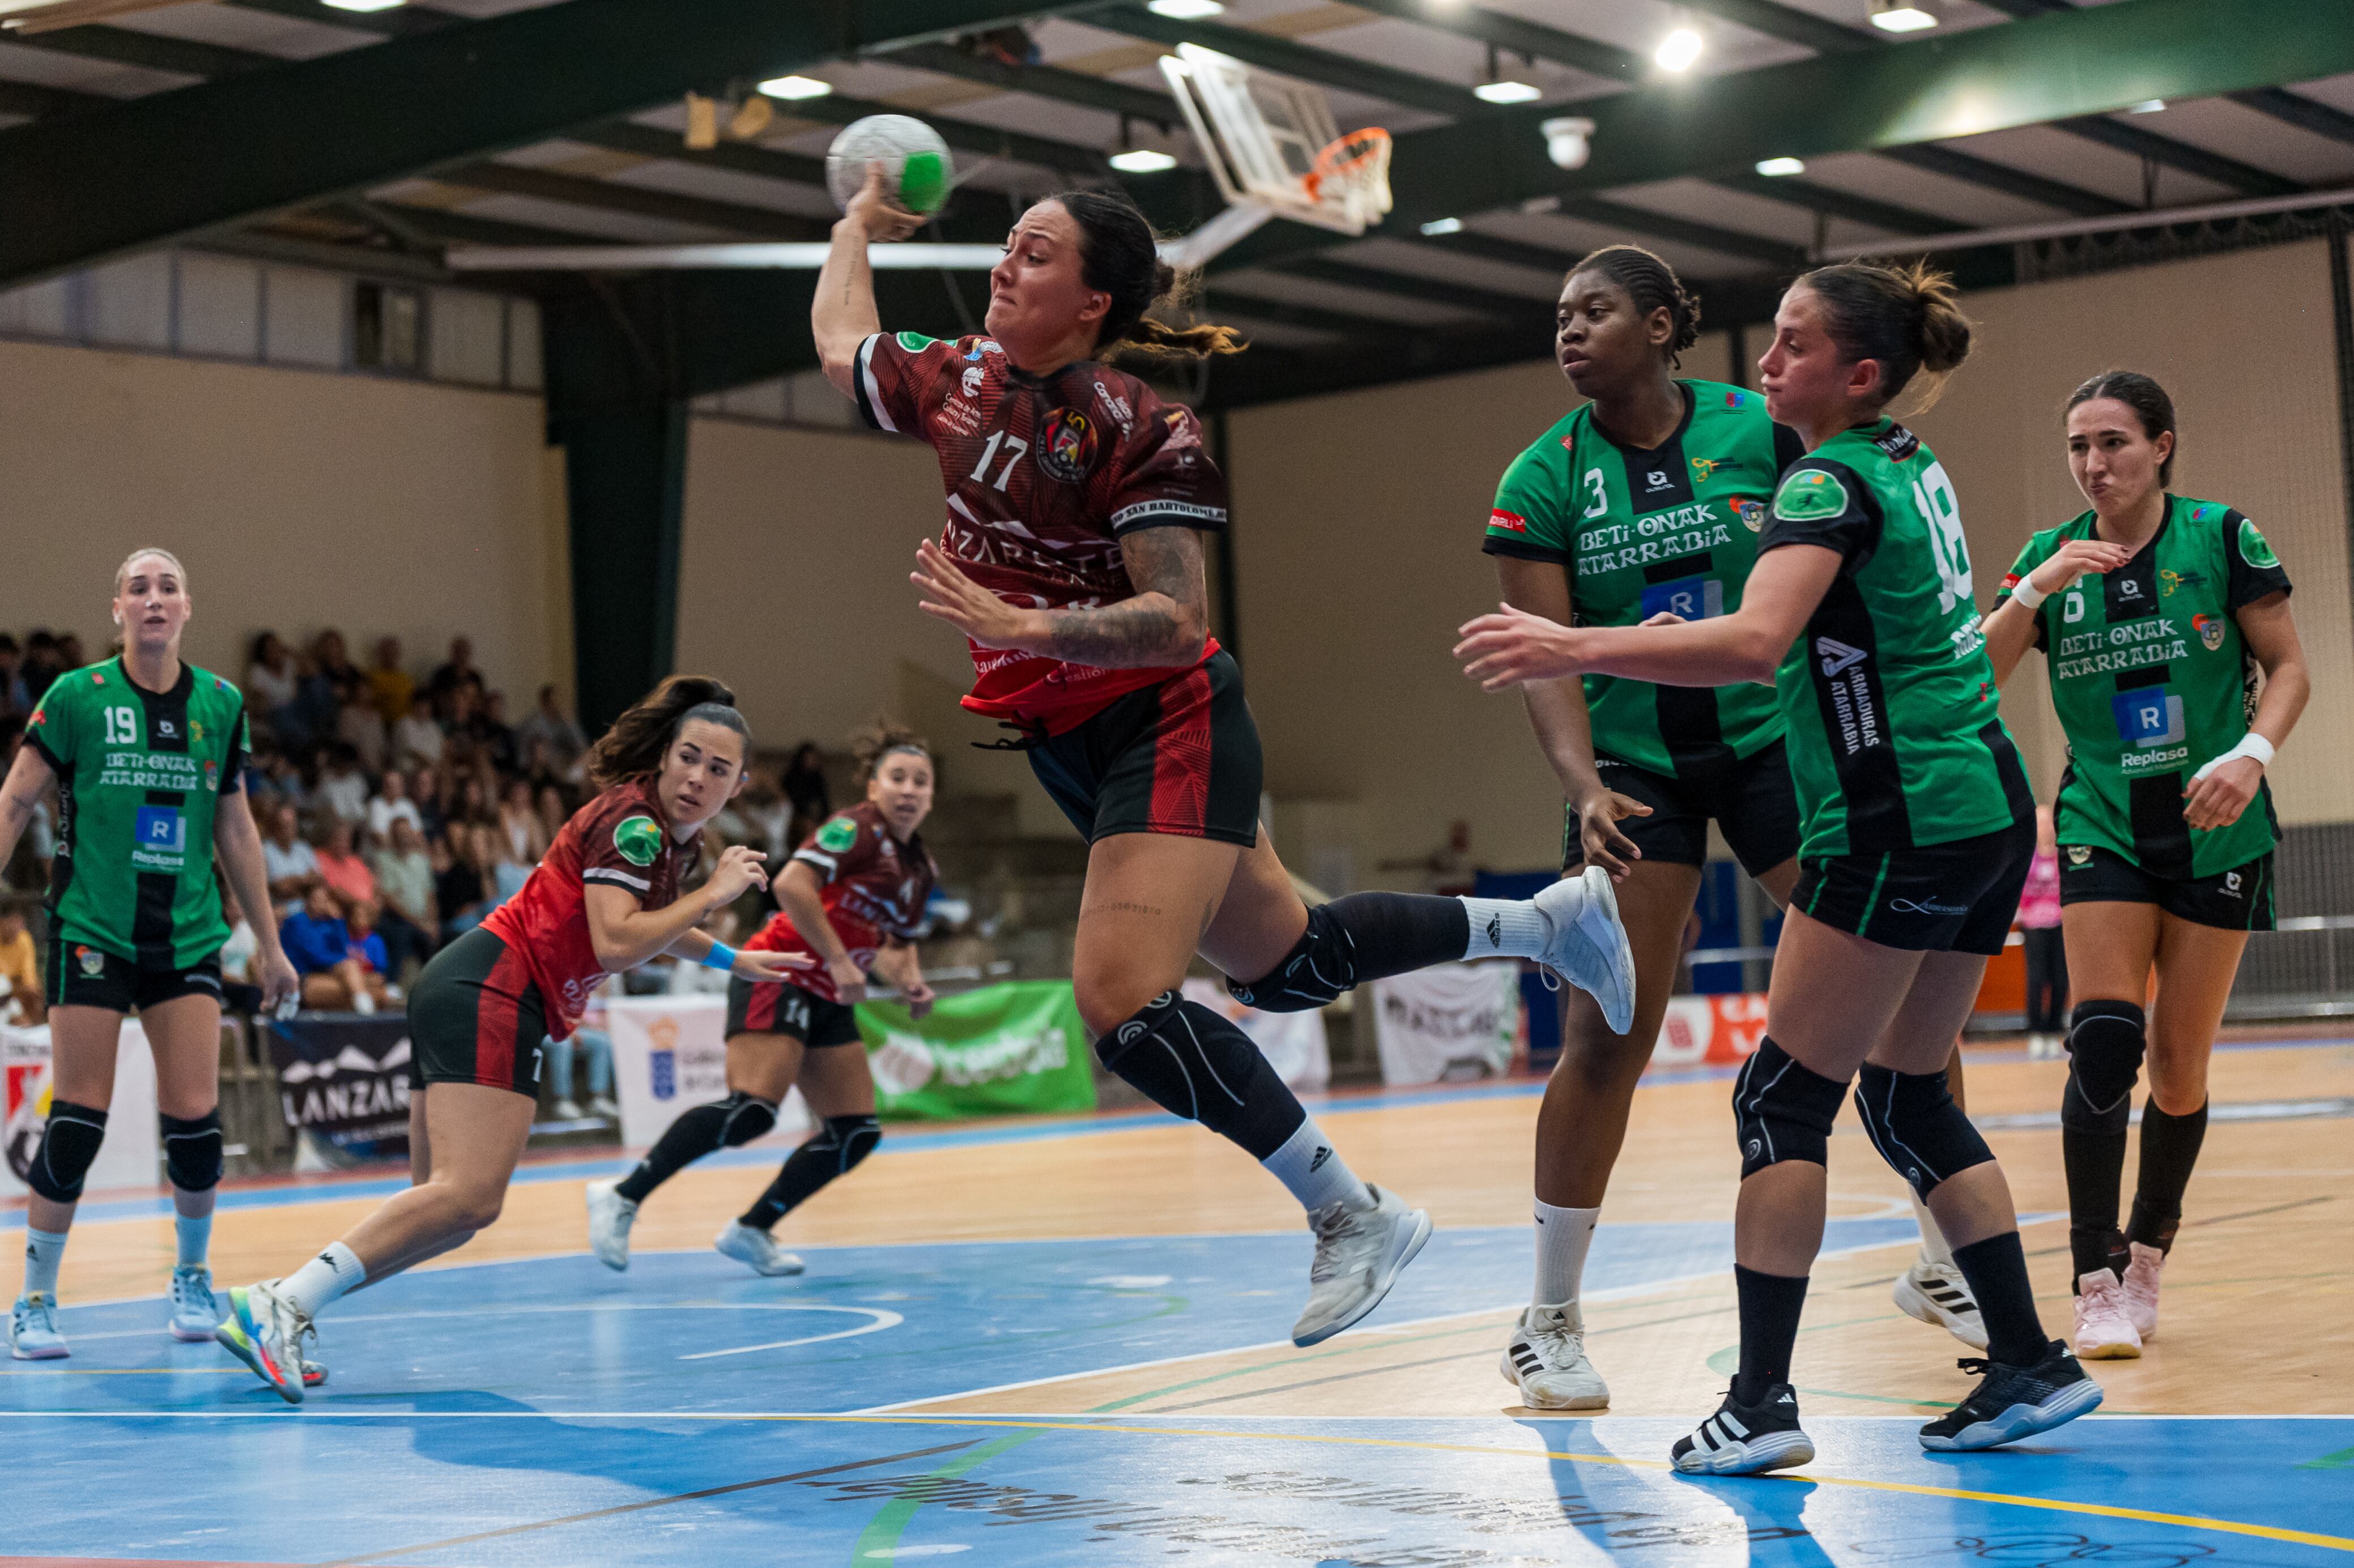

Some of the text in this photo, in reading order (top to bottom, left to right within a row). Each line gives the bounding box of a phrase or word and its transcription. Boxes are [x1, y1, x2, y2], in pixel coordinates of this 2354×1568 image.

[970, 429, 1029, 492] 17
[1583, 467, 1608, 518] 3
[1126, 504, 1146, 517] SAN
[1912, 461, 1973, 615] 18
[1669, 591, 1694, 614] R
[1831, 681, 1861, 756] ATARRABIA
[1848, 665, 1880, 747] ARMADURAS
[2139, 706, 2161, 730] R
[104, 706, 137, 744] 19
[2121, 746, 2188, 768] Replasa
[151, 820, 169, 838] R
[784, 998, 810, 1030] 14
